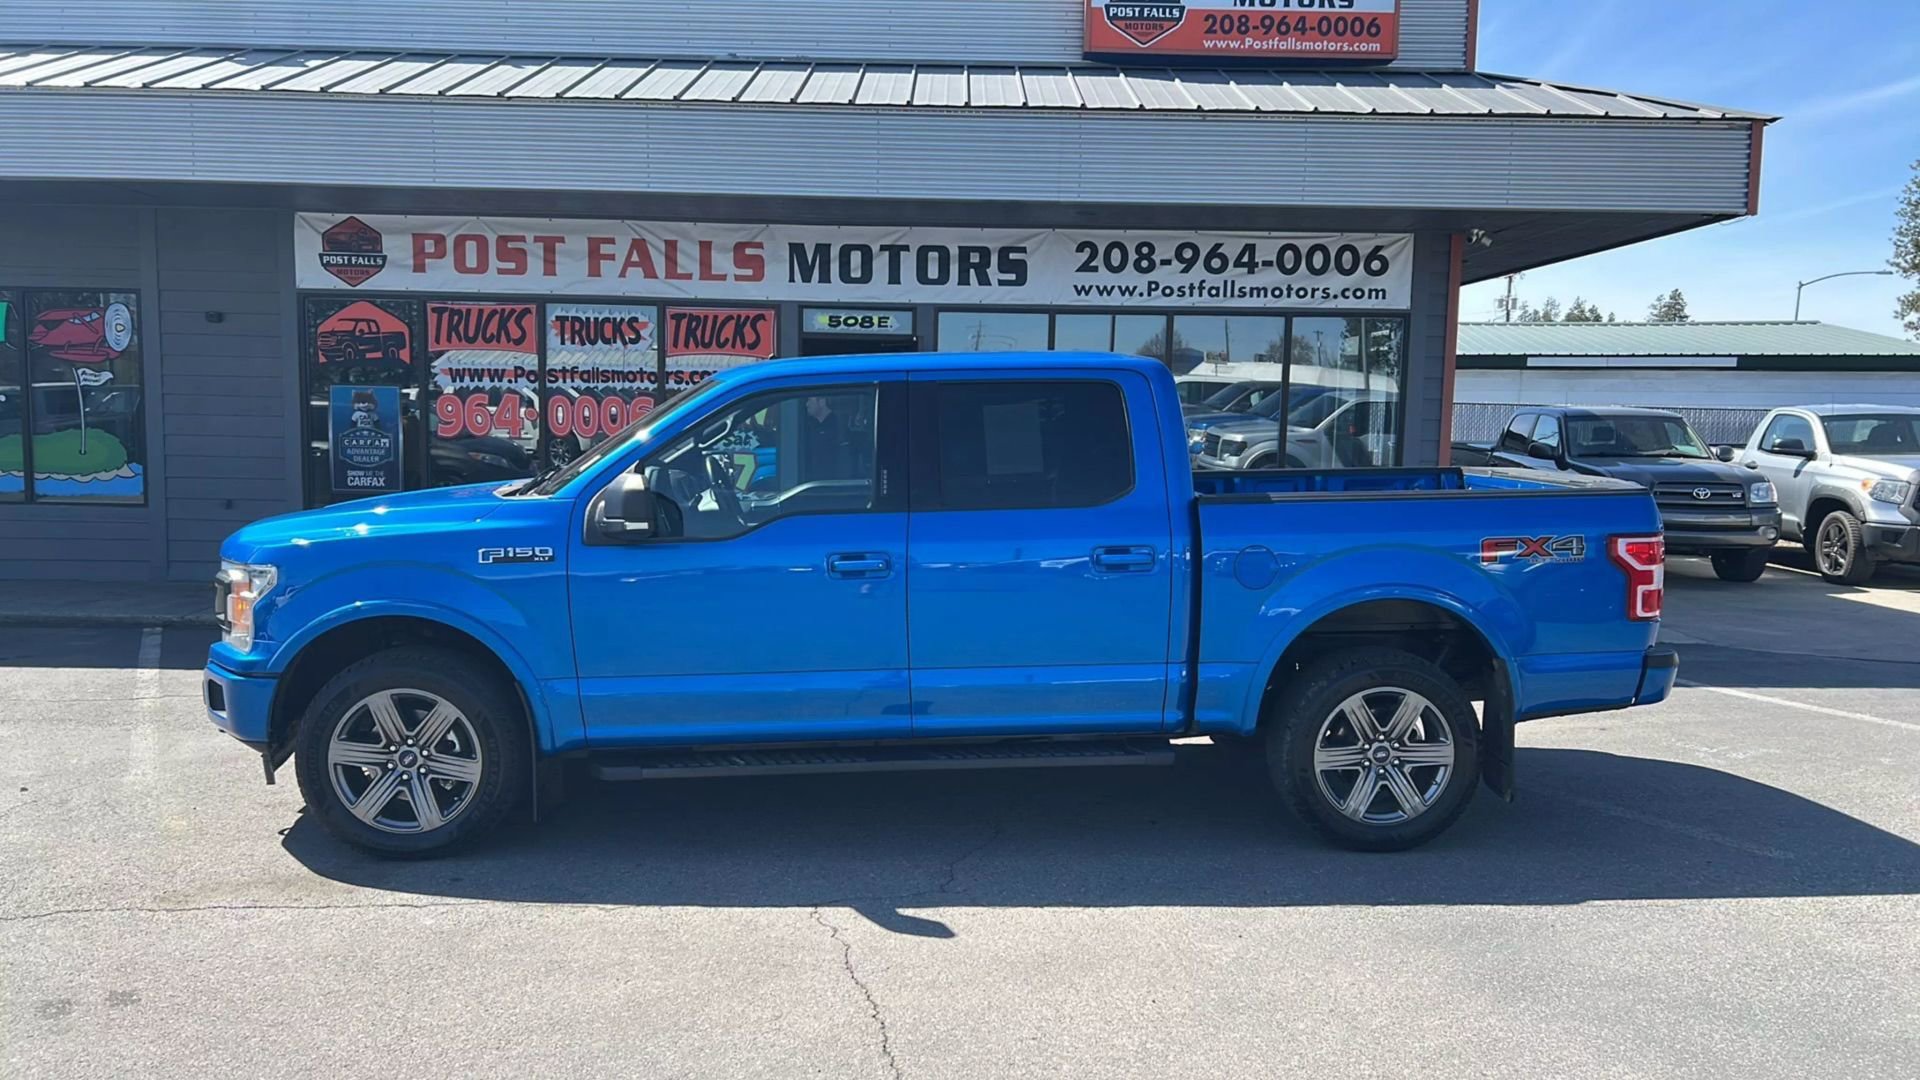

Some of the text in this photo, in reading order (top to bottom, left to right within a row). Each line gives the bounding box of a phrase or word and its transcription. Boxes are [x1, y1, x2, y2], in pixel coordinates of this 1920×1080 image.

[1109, 7, 1180, 18] POST FALLS
[1124, 22, 1165, 31] MOTORS
[1203, 14, 1382, 38] 208-964-0006
[1203, 37, 1381, 51] www.Postfallsmotors.com
[322, 255, 383, 265] POST FALLS
[412, 232, 1029, 287] POST FALLS MOTORS
[1074, 240, 1390, 278] 208-964-0006
[1073, 279, 1388, 301] www.Postfallsmotors.com
[431, 306, 533, 346] TRUCKS
[555, 315, 643, 348] TRUCKS
[670, 312, 768, 350] TRUCKS
[827, 315, 875, 329] 508
[344, 438, 390, 448] CARFAX
[347, 476, 386, 487] CARFAX
[1479, 534, 1586, 565] FX4
